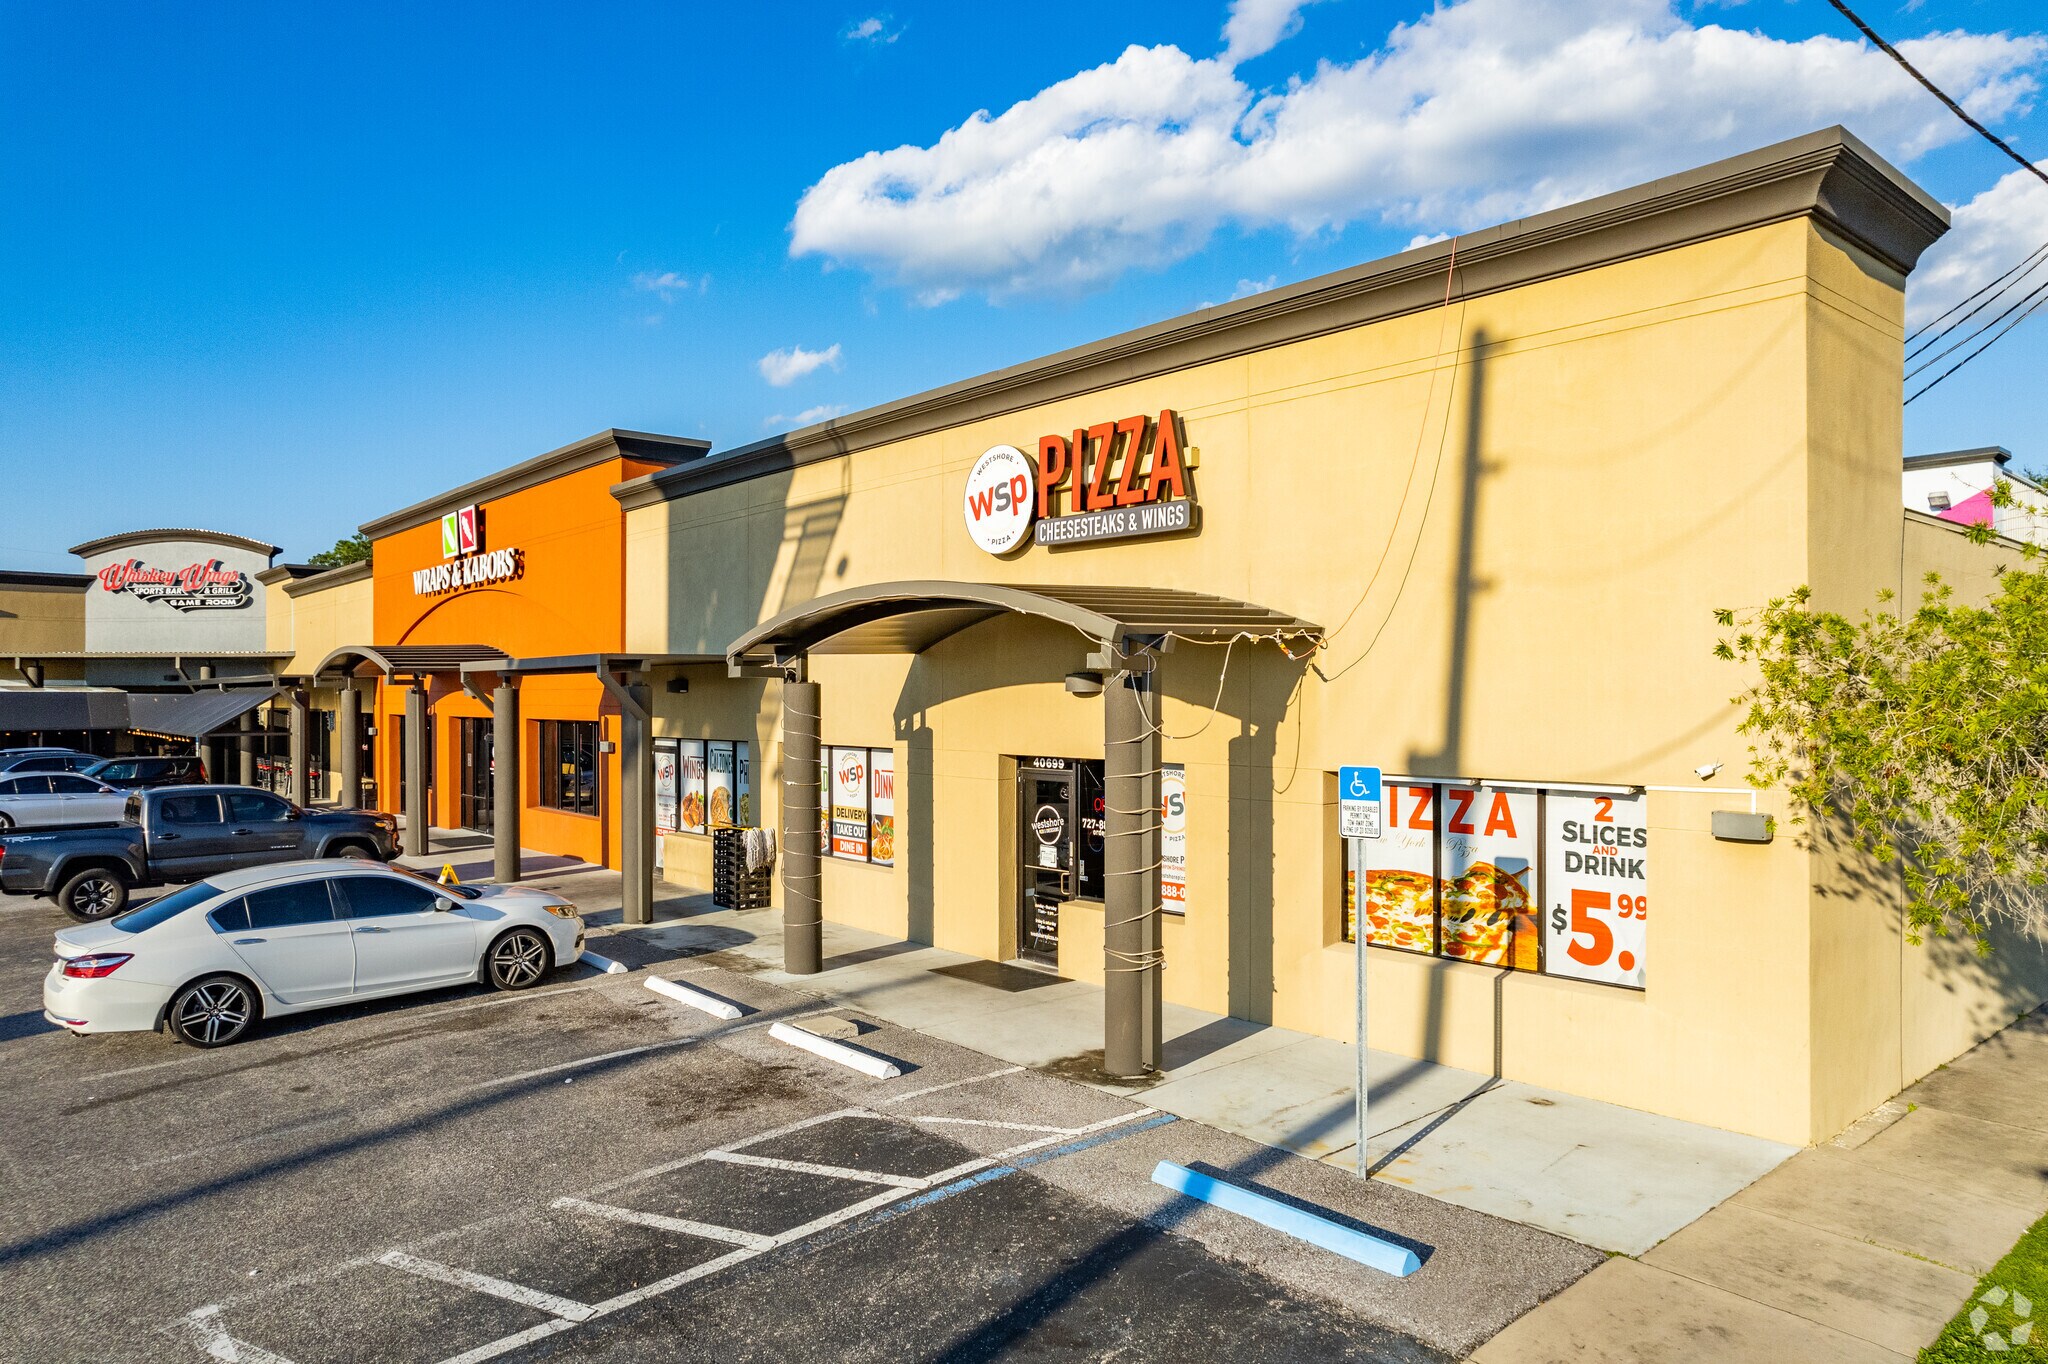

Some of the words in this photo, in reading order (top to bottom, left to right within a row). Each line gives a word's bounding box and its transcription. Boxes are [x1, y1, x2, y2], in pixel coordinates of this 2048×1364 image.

[976, 453, 1014, 476] WESTSHORE
[1037, 409, 1185, 518] PIZZA
[1039, 514, 1124, 542] CHEESESTEAKS
[1128, 515, 1138, 531] &
[1141, 504, 1184, 529] WINGS
[991, 534, 1011, 545] PIZZA
[98, 559, 176, 591] Whiskey
[178, 559, 239, 592] Wings
[412, 563, 452, 595] WRAPS
[451, 560, 462, 587] &
[463, 547, 515, 585] KABOBS
[133, 587, 164, 595] SPORTS
[166, 587, 182, 595] BAR
[212, 586, 235, 594] GRILL
[1033, 758, 1065, 769] 40699
[837, 807, 867, 820] DELIVERY
[1593, 796, 1614, 822] 2
[836, 823, 853, 836] TAKE
[853, 827, 866, 838] OUT
[1031, 818, 1064, 830] westshore
[1082, 818, 1105, 829] 727-8
[1562, 820, 1647, 848] SLICES
[840, 841, 855, 853] DINE
[855, 843, 863, 854] IN
[1446, 837, 1478, 858] Pizza
[1592, 845, 1618, 856] AND
[1565, 851, 1645, 880] DRINK
